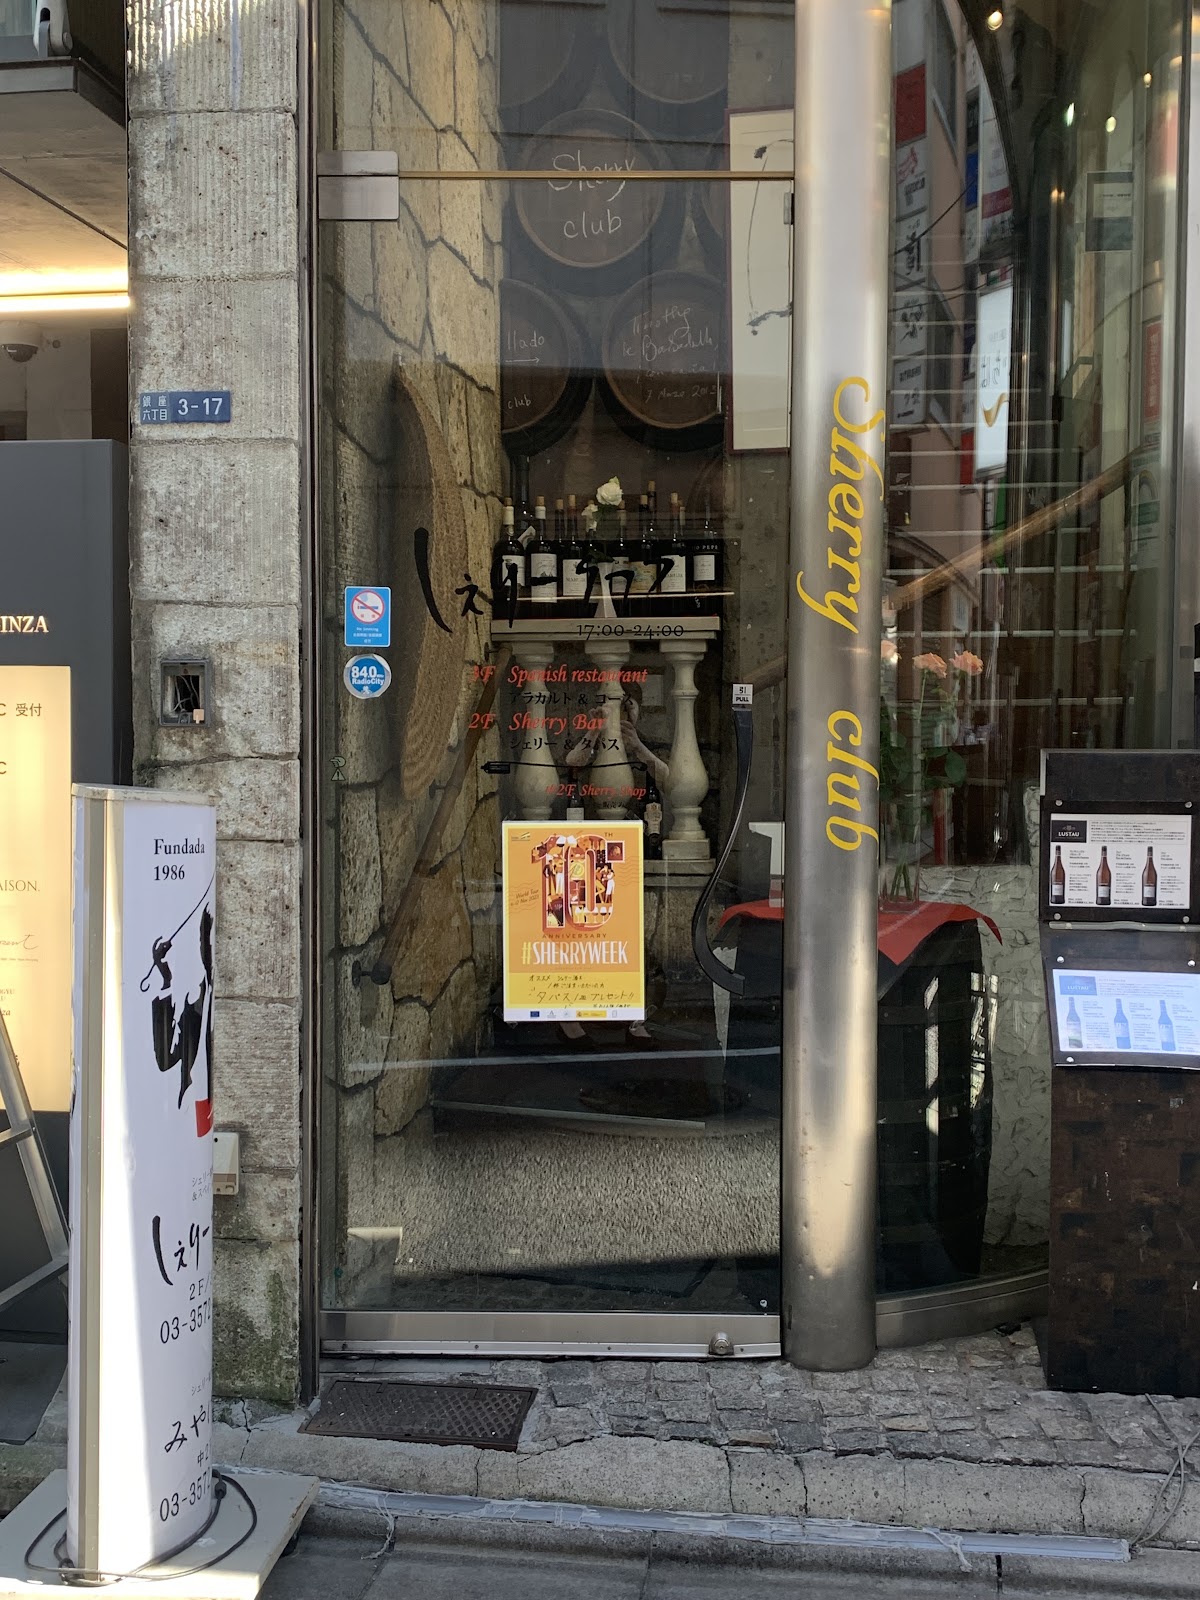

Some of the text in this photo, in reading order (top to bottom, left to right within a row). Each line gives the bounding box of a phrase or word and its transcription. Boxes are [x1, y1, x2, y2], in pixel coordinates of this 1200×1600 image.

[563, 209, 622, 239] club
[142, 395, 167, 407] 銀座
[178, 397, 223, 416] 3-17
[507, 397, 532, 410] club
[142, 409, 168, 421] 六丁目
[796, 376, 885, 853] Sherry club
[0, 615, 50, 633] INZA
[576, 623, 685, 641] 17:00-24:00
[351, 666, 377, 678] 84.0
[508, 664, 568, 688] Spanish
[571, 666, 649, 683] restaurant
[509, 692, 572, 705] アラカルト
[578, 692, 588, 705] &
[739, 686, 746, 694] 引
[15, 702, 42, 717] 受付
[468, 712, 609, 736] 2F Sherry Bar
[510, 737, 620, 751] シェリー & タパス
[153, 838, 206, 857] Fundada
[153, 865, 185, 881] 1986
[521, 941, 629, 965] #SHERRYWEEK
[152, 1215, 210, 1286] しぇりー
